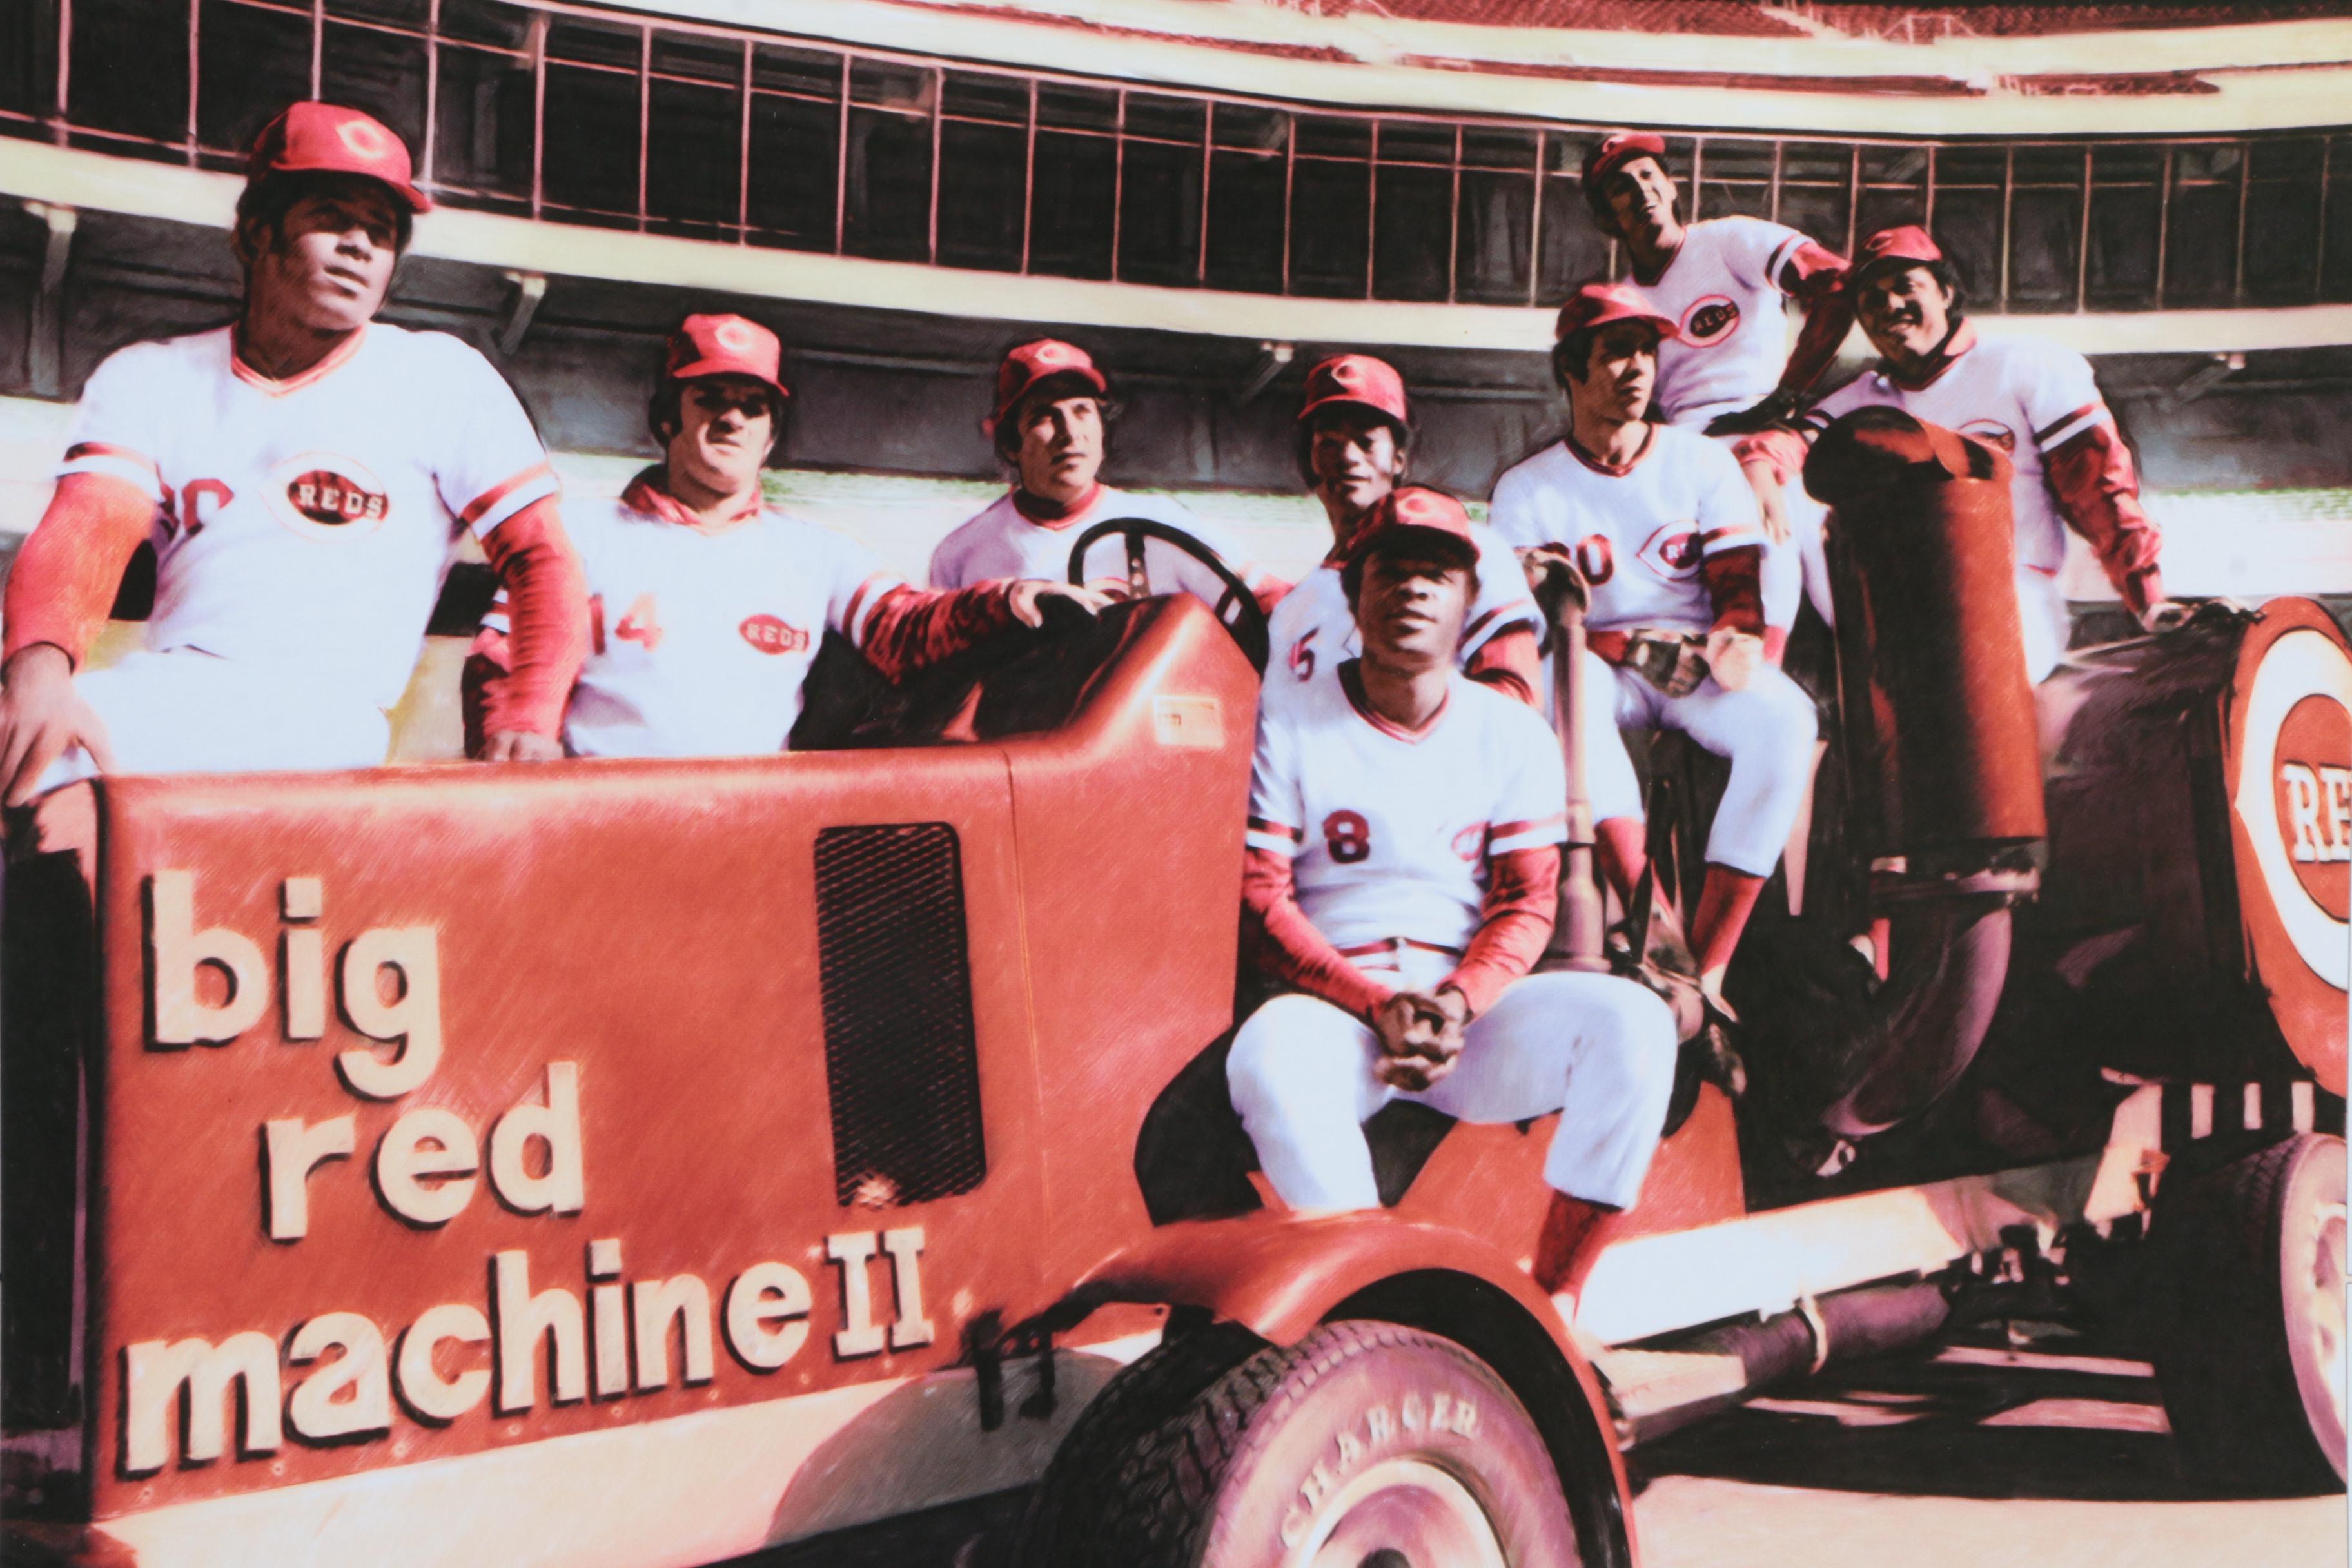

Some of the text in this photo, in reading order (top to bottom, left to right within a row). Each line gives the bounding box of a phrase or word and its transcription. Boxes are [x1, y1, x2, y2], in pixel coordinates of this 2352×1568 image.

[298, 484, 386, 520] REDS
[587, 592, 664, 656] 14
[746, 622, 807, 652] REDS
[1322, 809, 1371, 864] 8
[143, 869, 445, 1100] big
[261, 1060, 584, 1242] red
[118, 1226, 935, 1479] machine II
[1280, 1391, 1480, 1550] CHARGER
